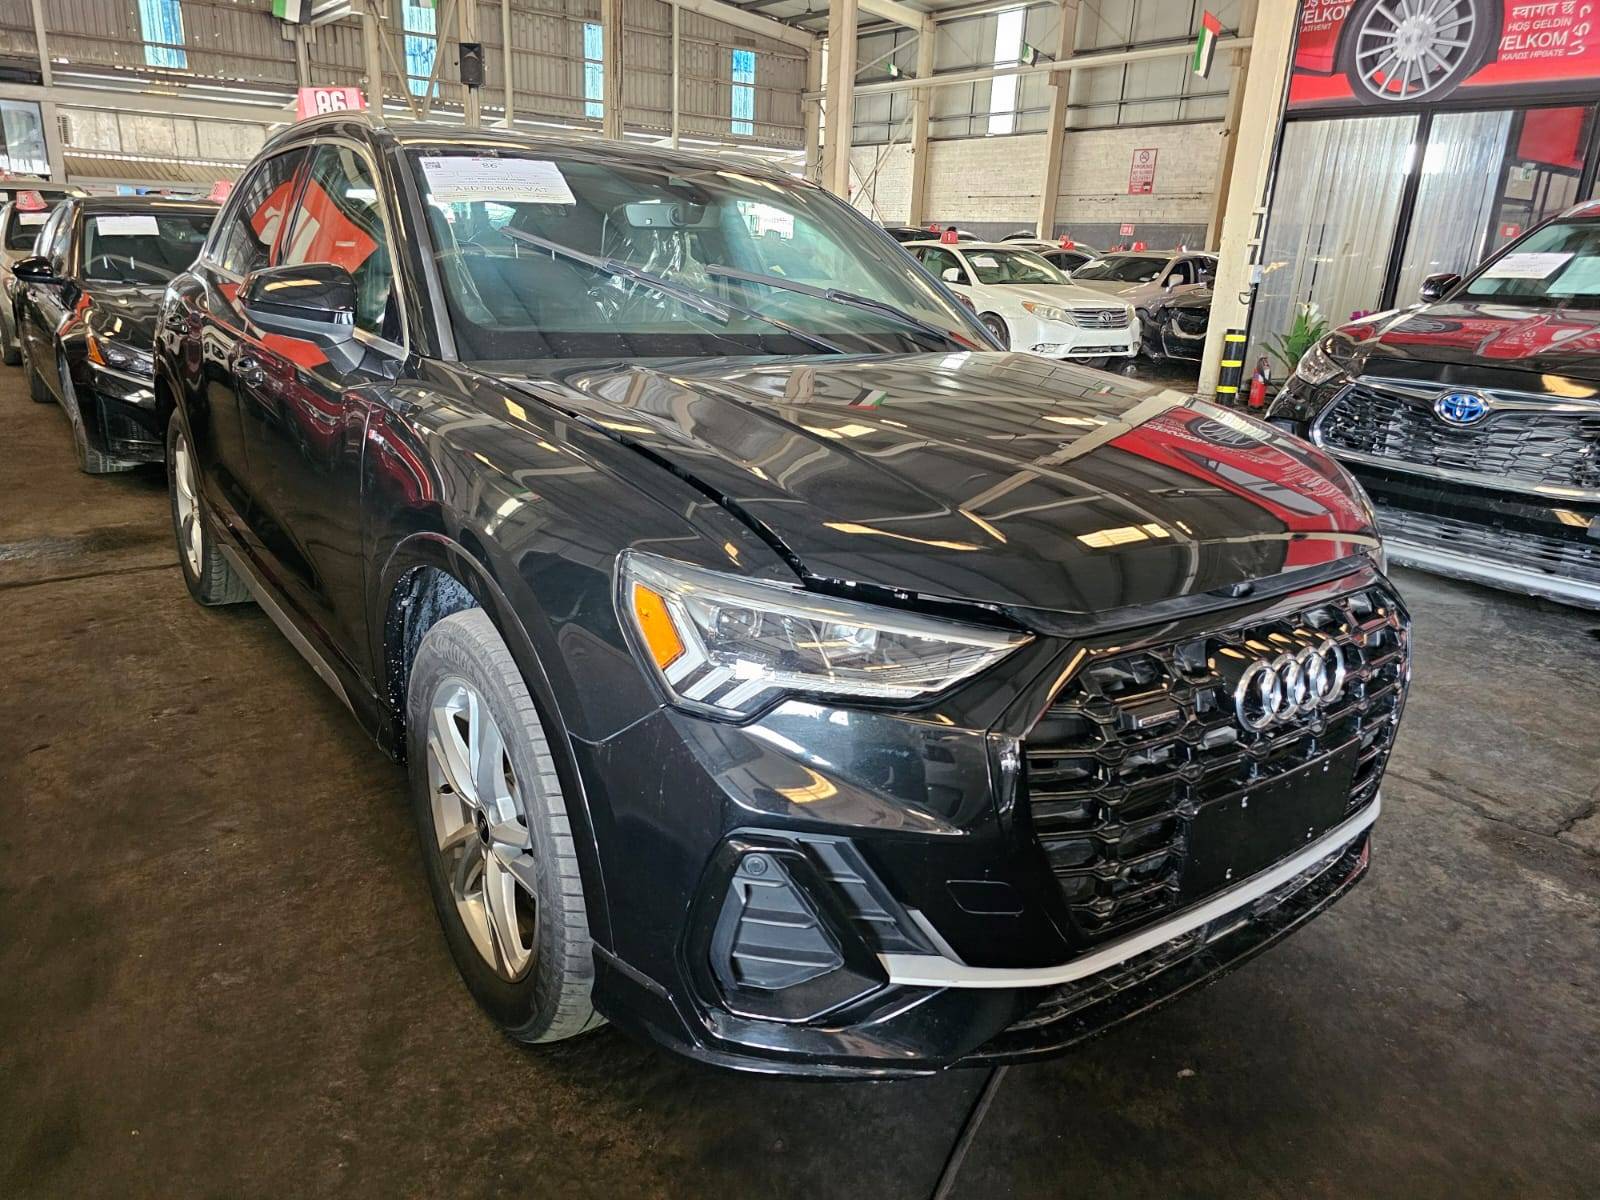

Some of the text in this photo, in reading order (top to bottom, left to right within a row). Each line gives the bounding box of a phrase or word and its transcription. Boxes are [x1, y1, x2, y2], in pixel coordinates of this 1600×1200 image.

[1301, 5, 1351, 24] ELKO
[1498, 30, 1568, 50] ELKOM
[315, 90, 348, 114] 86
